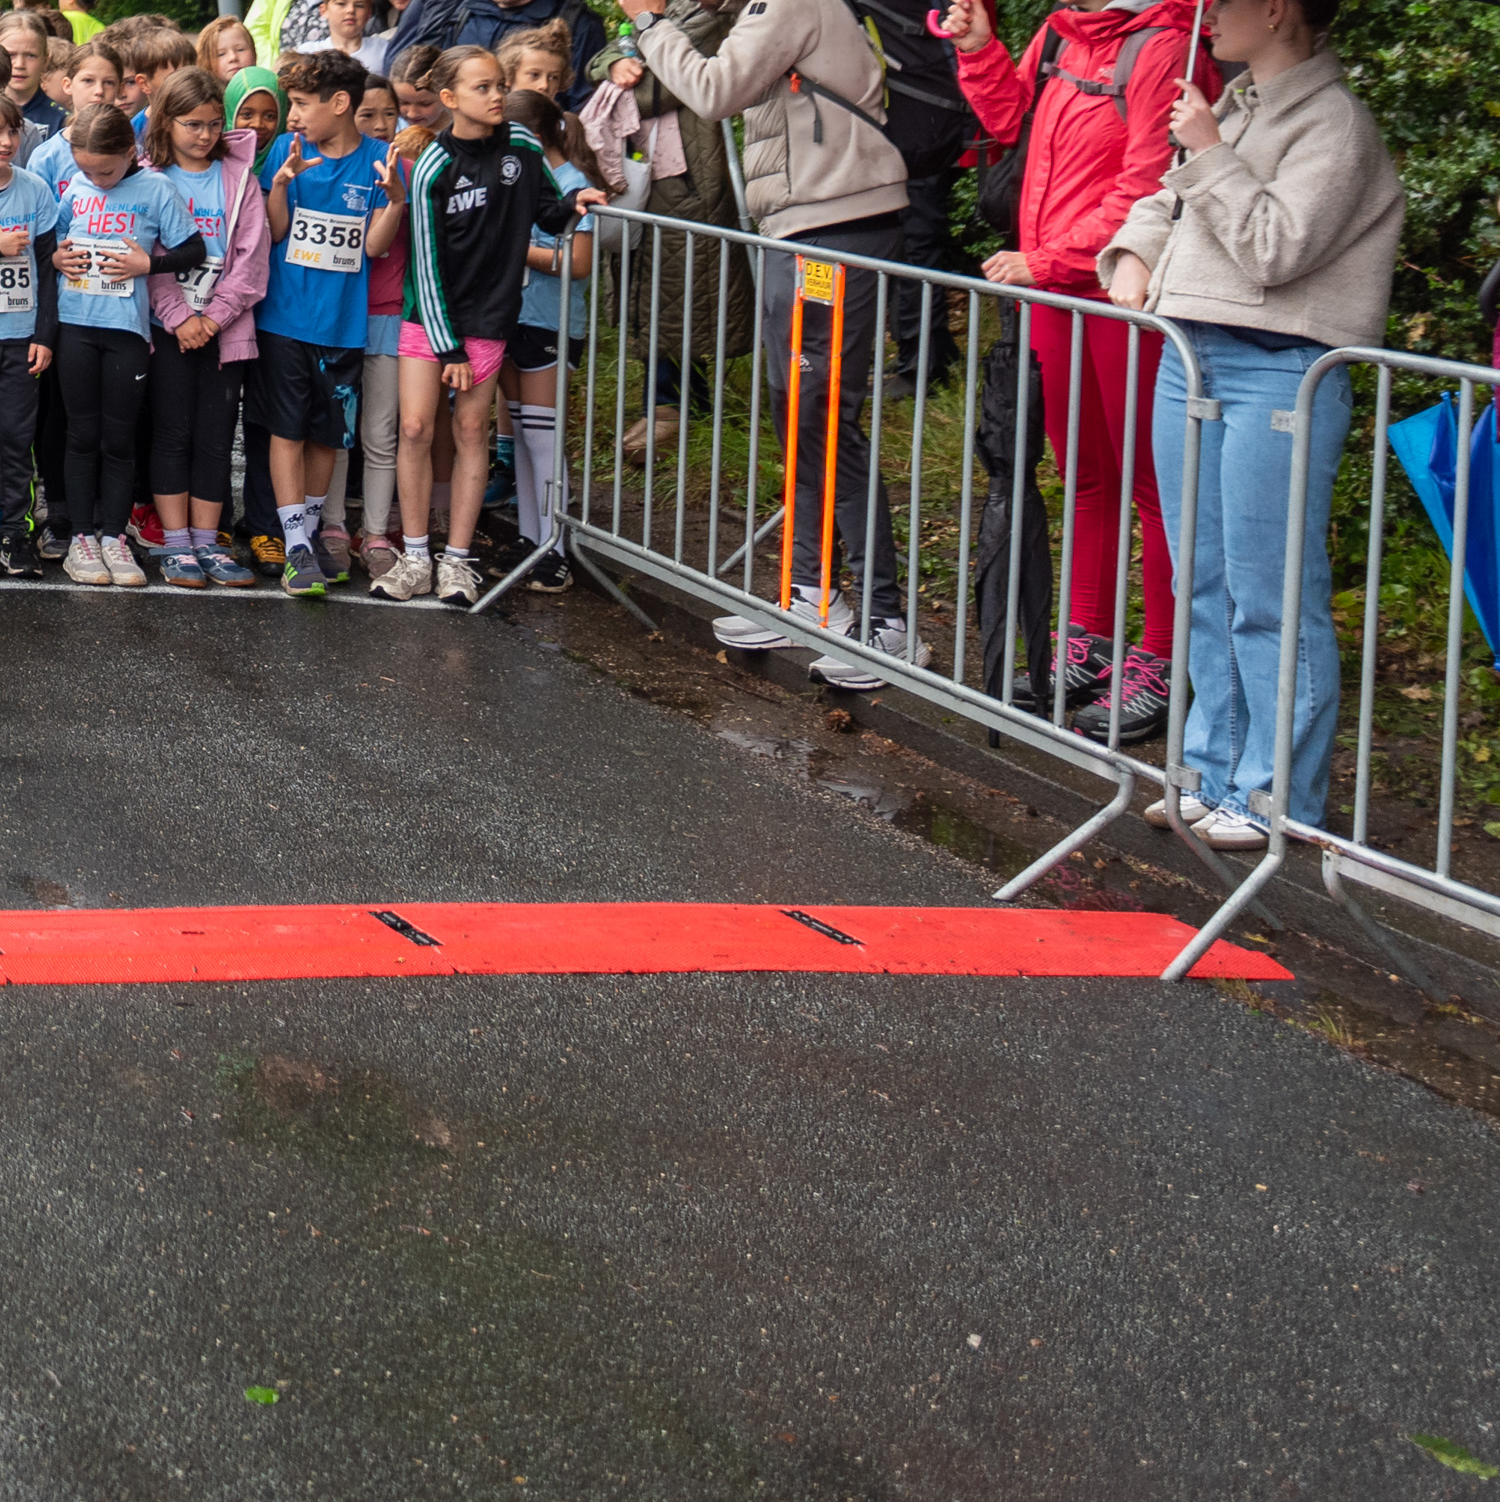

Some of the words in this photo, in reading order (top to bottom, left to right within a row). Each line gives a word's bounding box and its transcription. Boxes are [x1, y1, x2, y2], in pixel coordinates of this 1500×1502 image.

[445, 186, 488, 214] EWE
[87, 212, 136, 235] HES!
[292, 219, 362, 249] 3358
[293, 248, 322, 263] EWE
[332, 254, 356, 266] bruns
[101, 280, 127, 290] bruns
[7, 296, 29, 306] bruns
